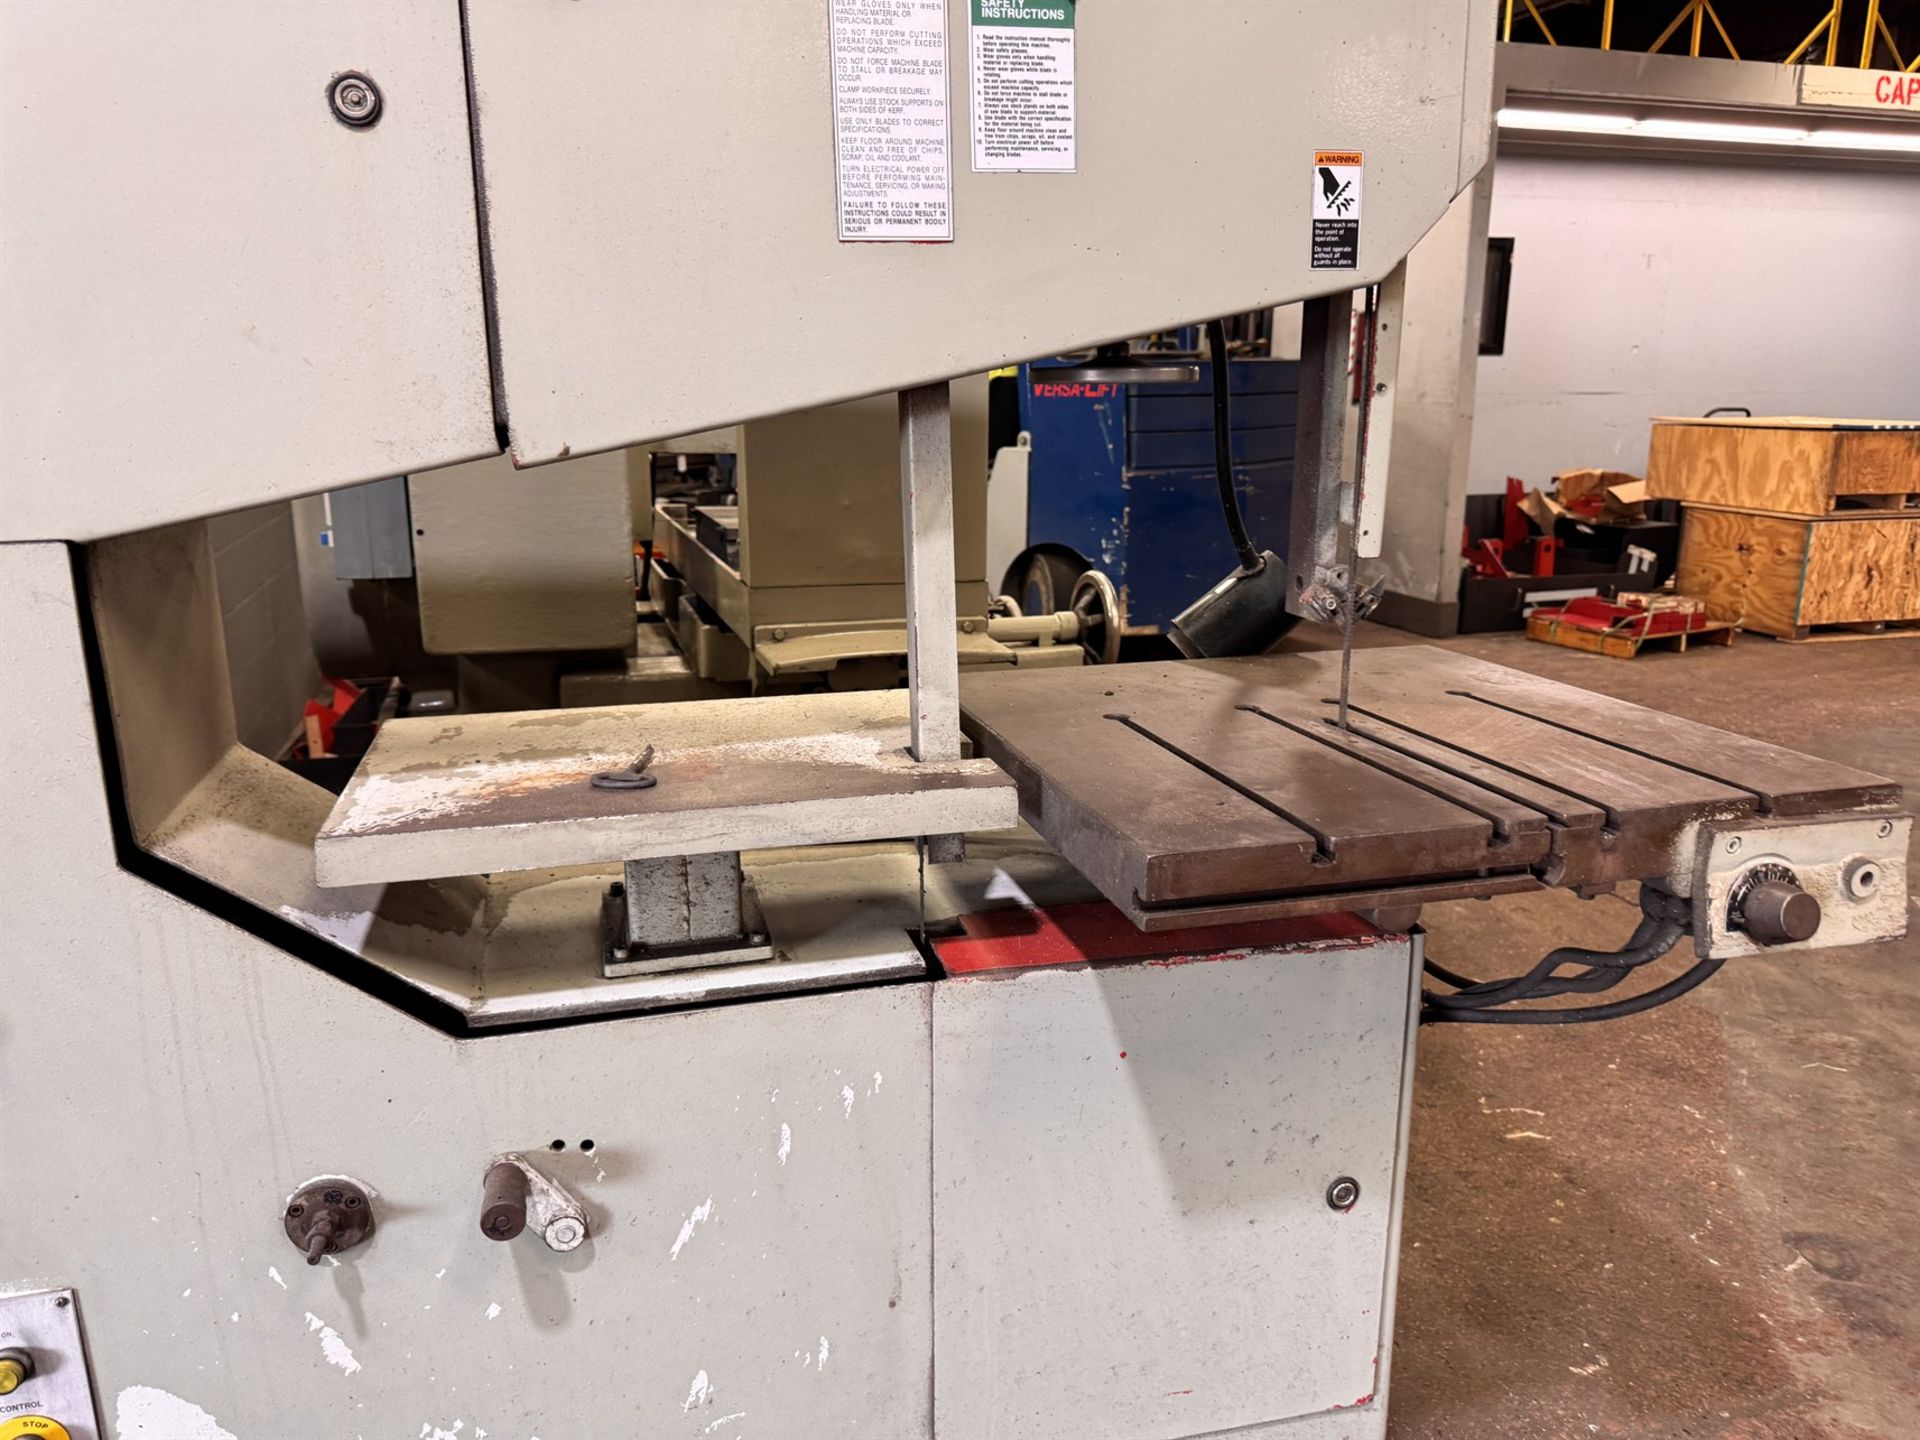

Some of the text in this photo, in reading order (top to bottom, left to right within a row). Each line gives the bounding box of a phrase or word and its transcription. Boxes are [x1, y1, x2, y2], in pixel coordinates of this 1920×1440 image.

[982, 8, 1064, 20] INSTRUCTIONS
[1876, 76, 1920, 104] CAP
[0, 1401, 43, 1413] CONTROL
